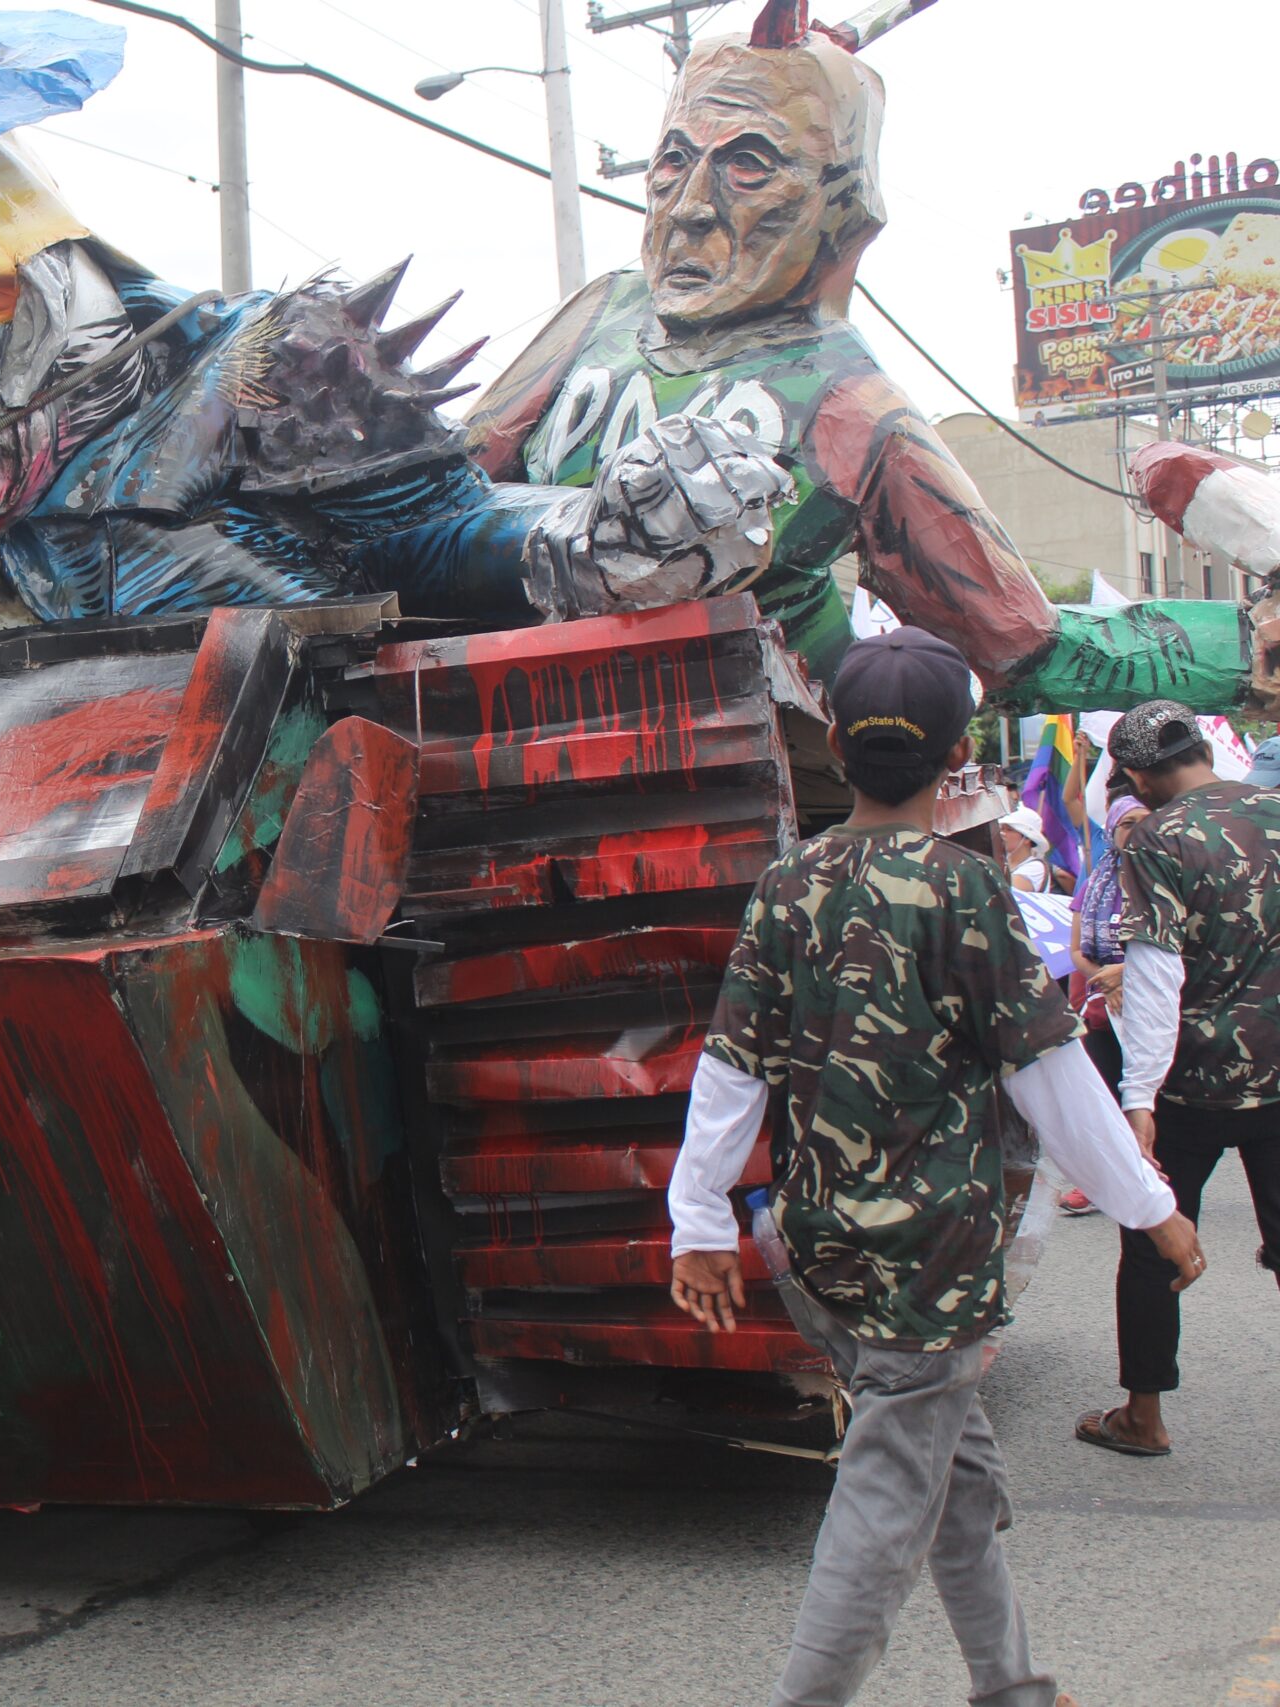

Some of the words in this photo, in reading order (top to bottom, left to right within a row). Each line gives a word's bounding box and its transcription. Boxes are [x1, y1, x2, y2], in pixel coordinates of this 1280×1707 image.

[1028, 301, 1111, 330] SISIG
[1041, 333, 1114, 361] PORKY
[1050, 350, 1104, 371] PORK
[1112, 371, 1133, 384] ITO
[847, 719, 869, 737] Golden
[868, 716, 894, 726] State
